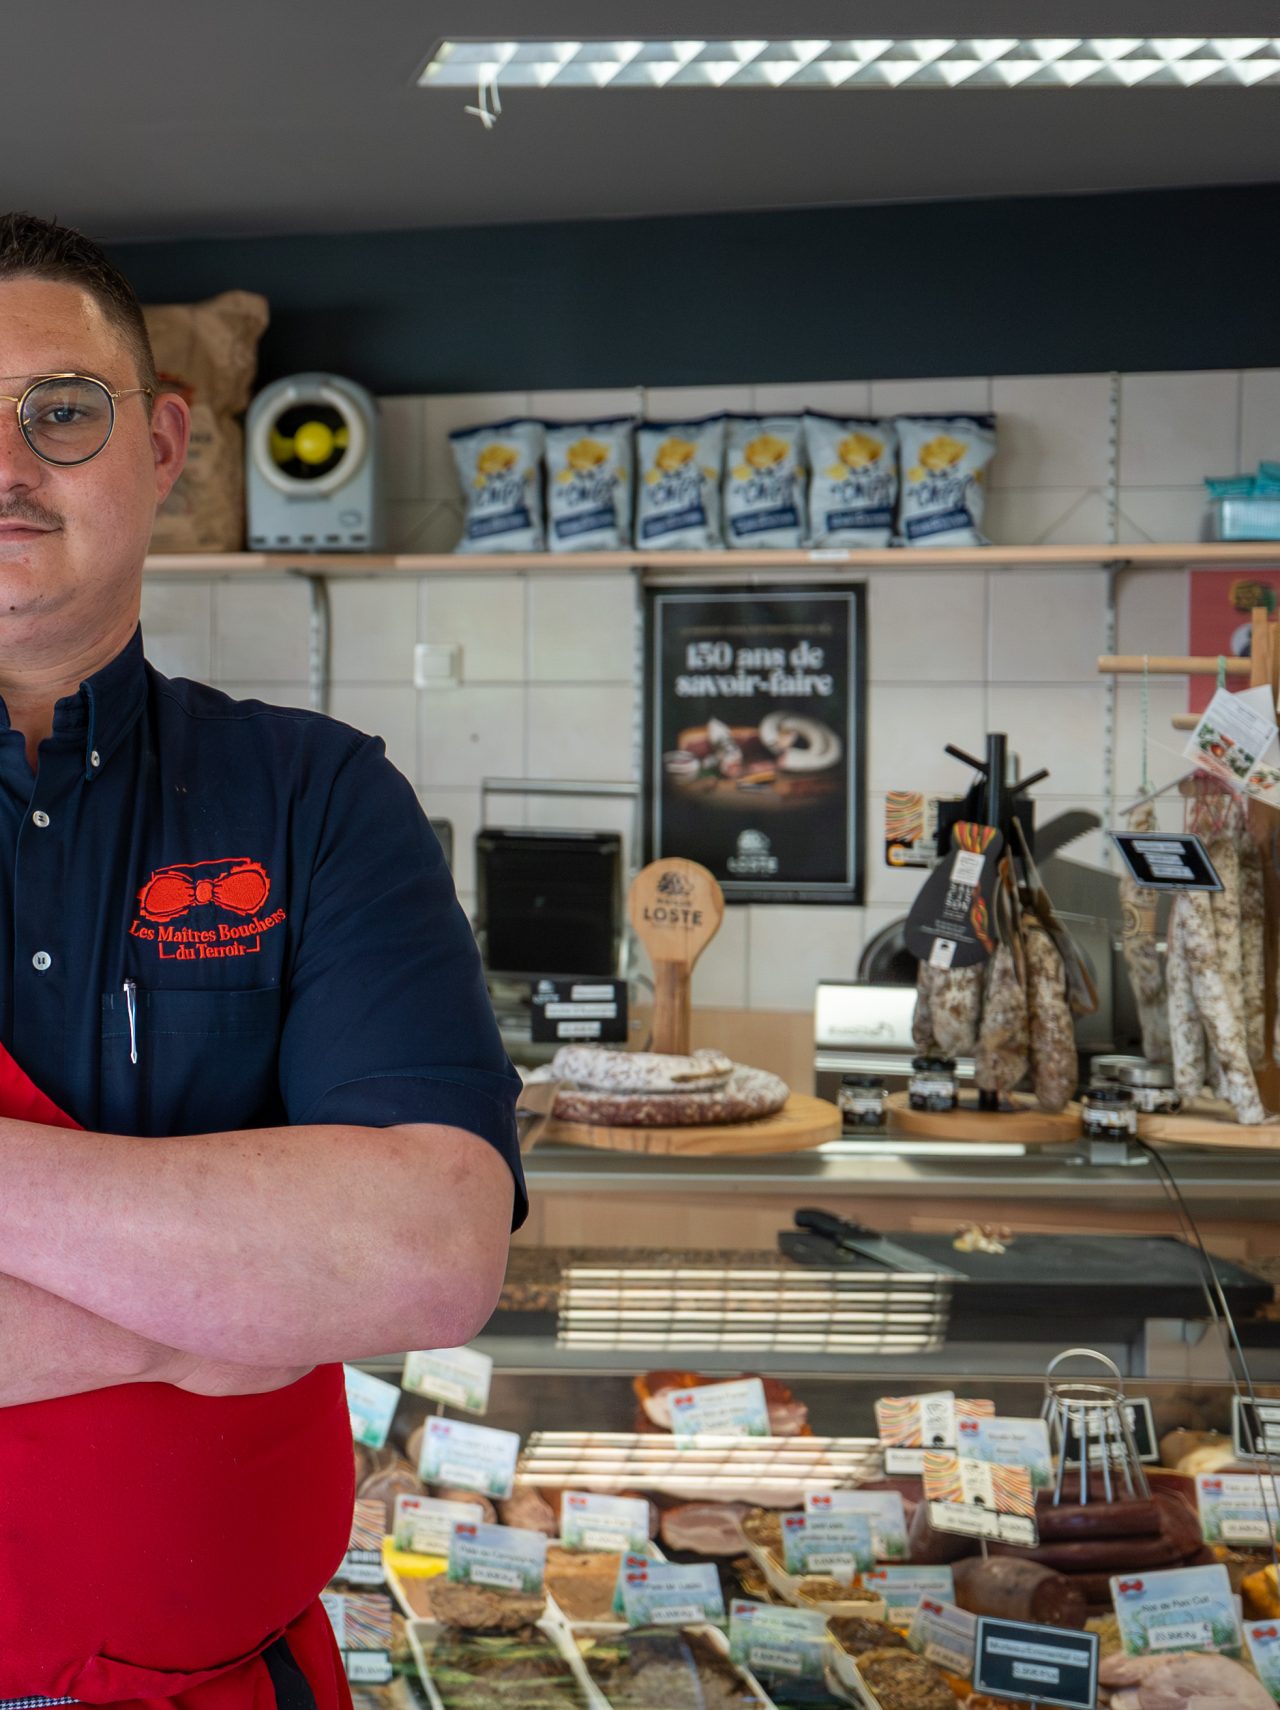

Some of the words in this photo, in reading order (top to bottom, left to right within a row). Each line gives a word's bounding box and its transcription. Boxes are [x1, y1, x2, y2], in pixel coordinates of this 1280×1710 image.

[686, 641, 732, 670] 150
[736, 647, 785, 670] ans
[789, 640, 824, 670] de
[675, 667, 833, 697] savoir-faire
[128, 920, 155, 941] Les
[157, 925, 217, 943] Maîtres
[217, 907, 287, 941] Bouchers
[644, 905, 703, 927] LOSTE
[176, 945, 196, 960] du
[196, 941, 247, 959] Terroir
